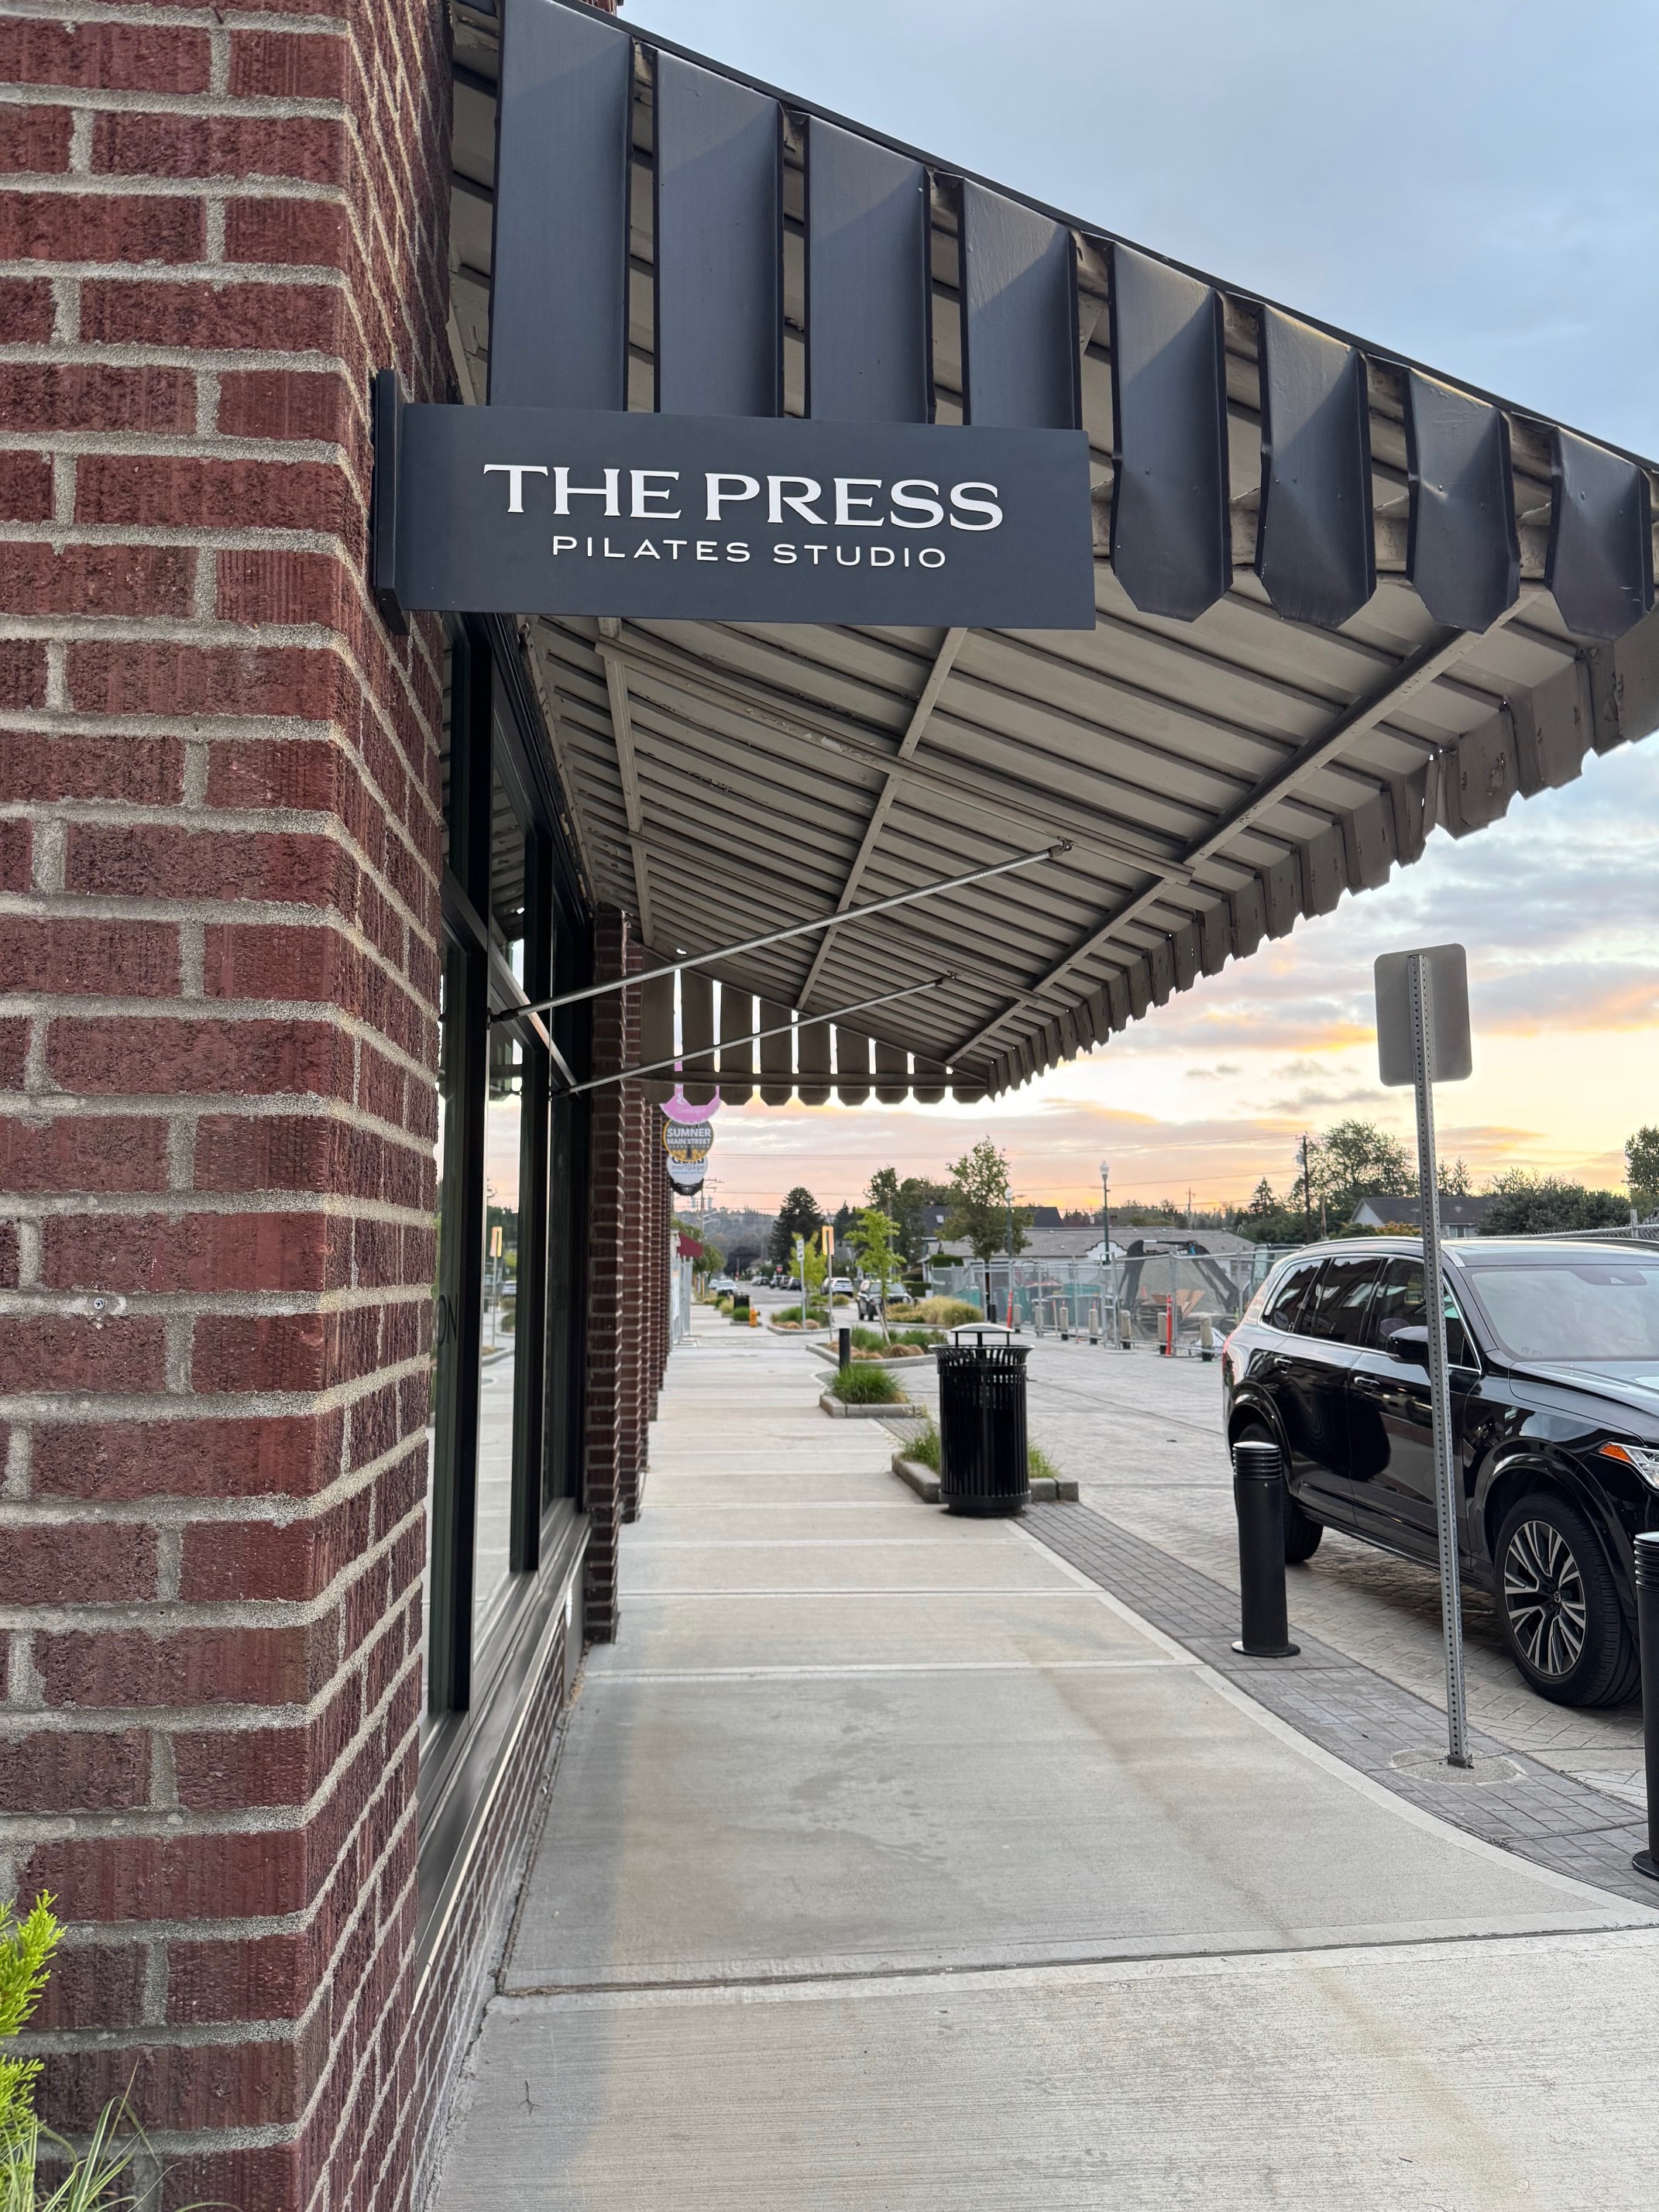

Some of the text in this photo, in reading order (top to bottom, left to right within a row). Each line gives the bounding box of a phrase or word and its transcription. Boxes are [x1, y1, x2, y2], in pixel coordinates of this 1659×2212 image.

[483, 464, 1003, 531] THE PRESS
[552, 535, 946, 568] PILATES STUDIO
[667, 1128, 711, 1137] SUMNER
